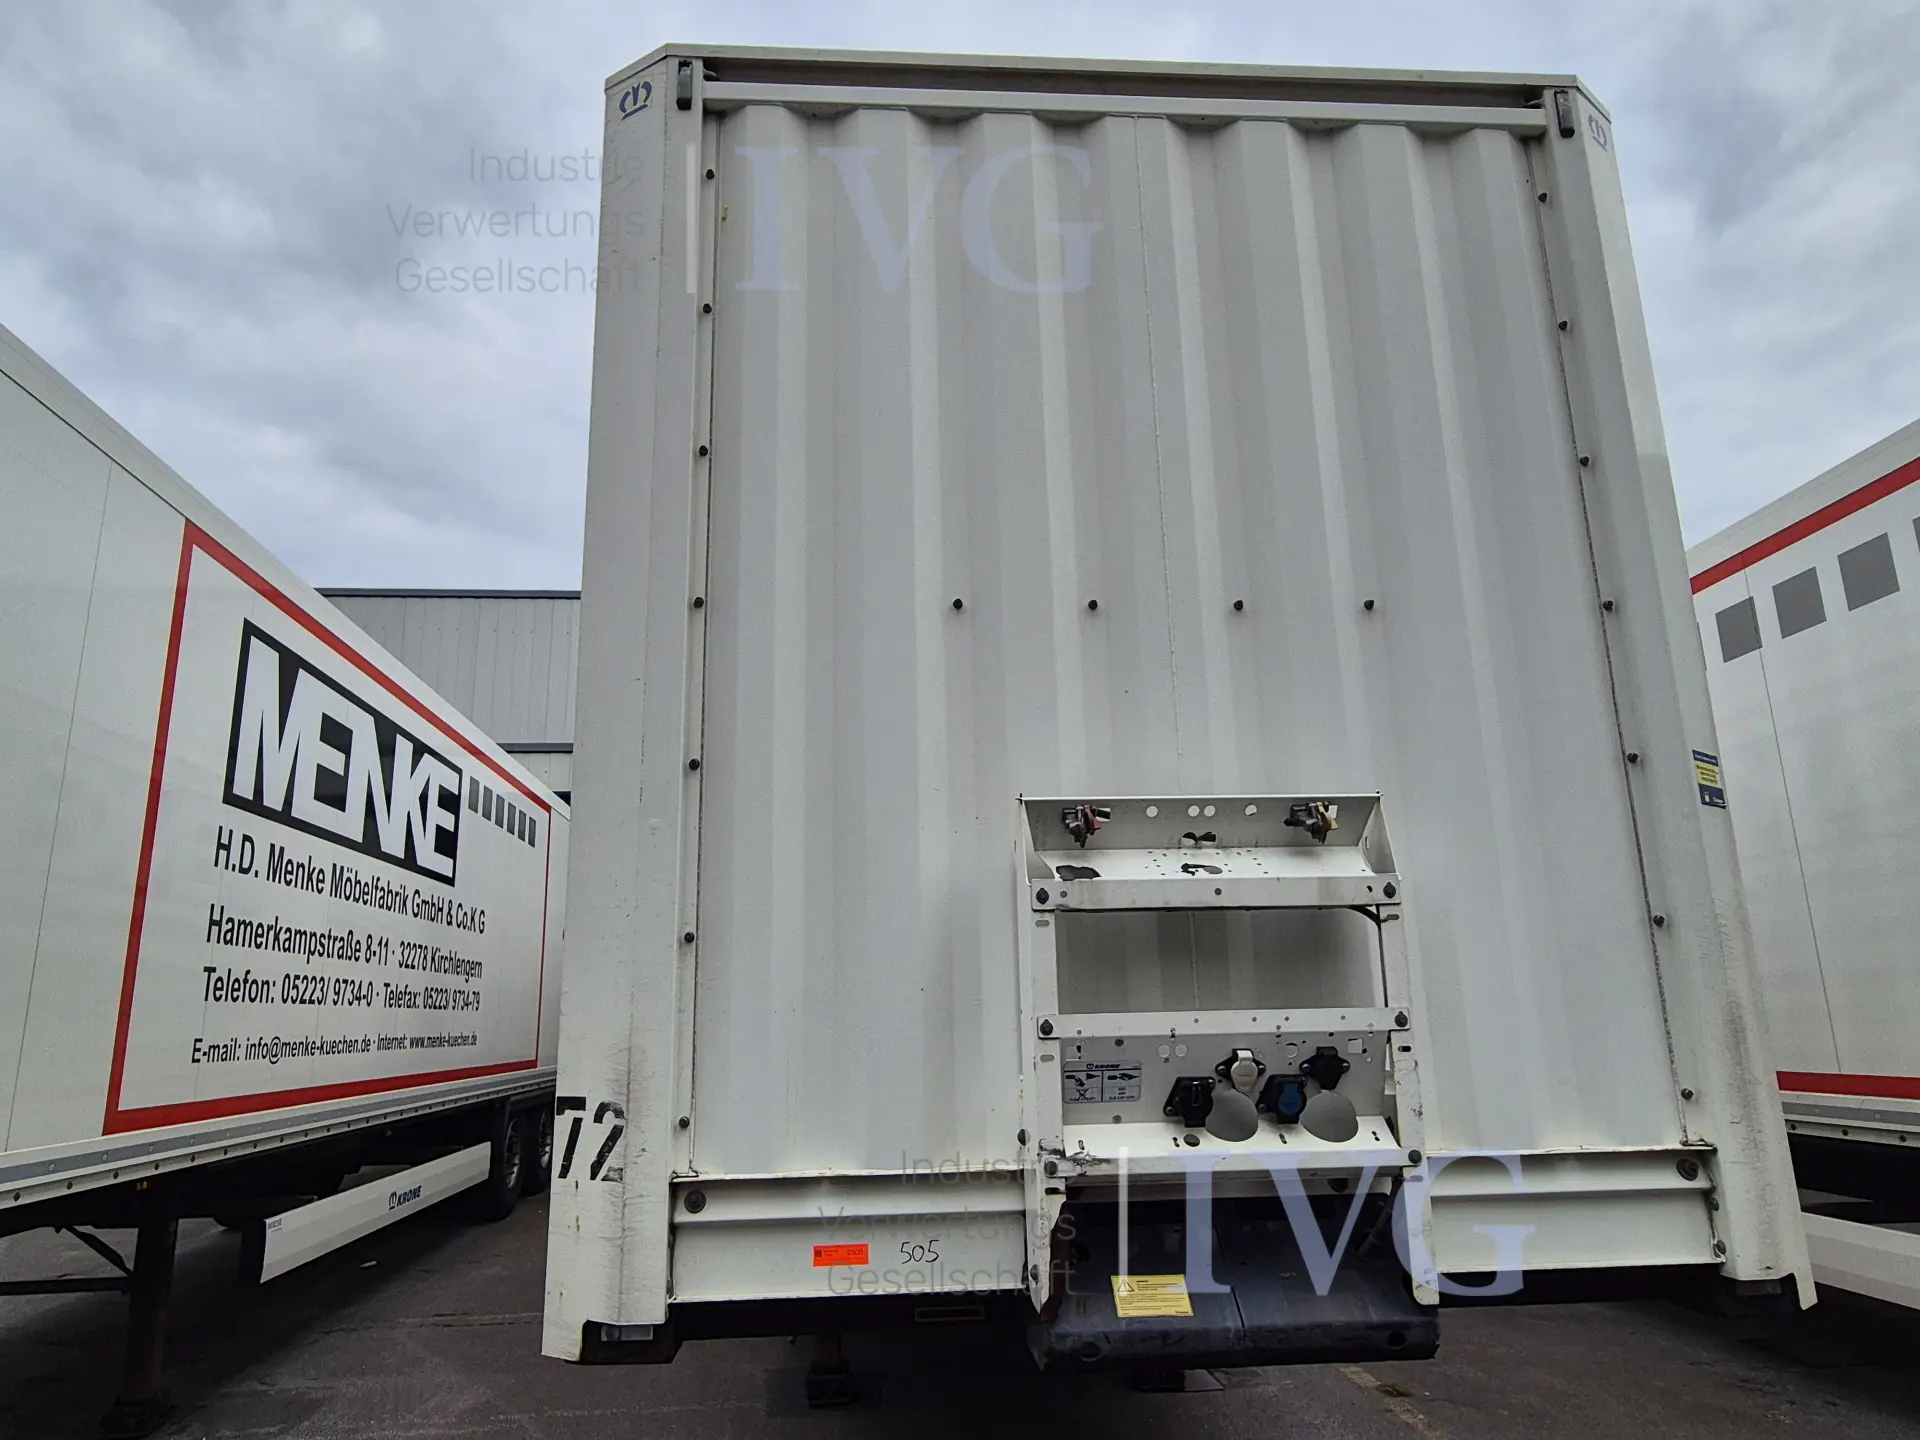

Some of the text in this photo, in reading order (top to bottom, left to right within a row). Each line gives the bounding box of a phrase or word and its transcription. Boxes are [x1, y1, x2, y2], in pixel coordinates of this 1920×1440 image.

[231, 633, 461, 880] MENKE
[213, 825, 259, 878] H.D.
[266, 842, 326, 895] Menke
[329, 862, 409, 916] Möbelfabrik
[411, 888, 445, 925] GmbH
[446, 899, 454, 926] &
[206, 903, 482, 983] Hamerkampstraße 8-11 32278 Kirchlengern
[203, 966, 276, 1004] Telefon:
[383, 982, 420, 1009] Telefax:
[191, 1031, 478, 1065] E-mail: info@menke-kuechen.de Internet: www.menke-kuechen.de
[556, 1096, 626, 1182] 72
[396, 1185, 423, 1208] KRONE
[900, 1240, 940, 1264] 505
